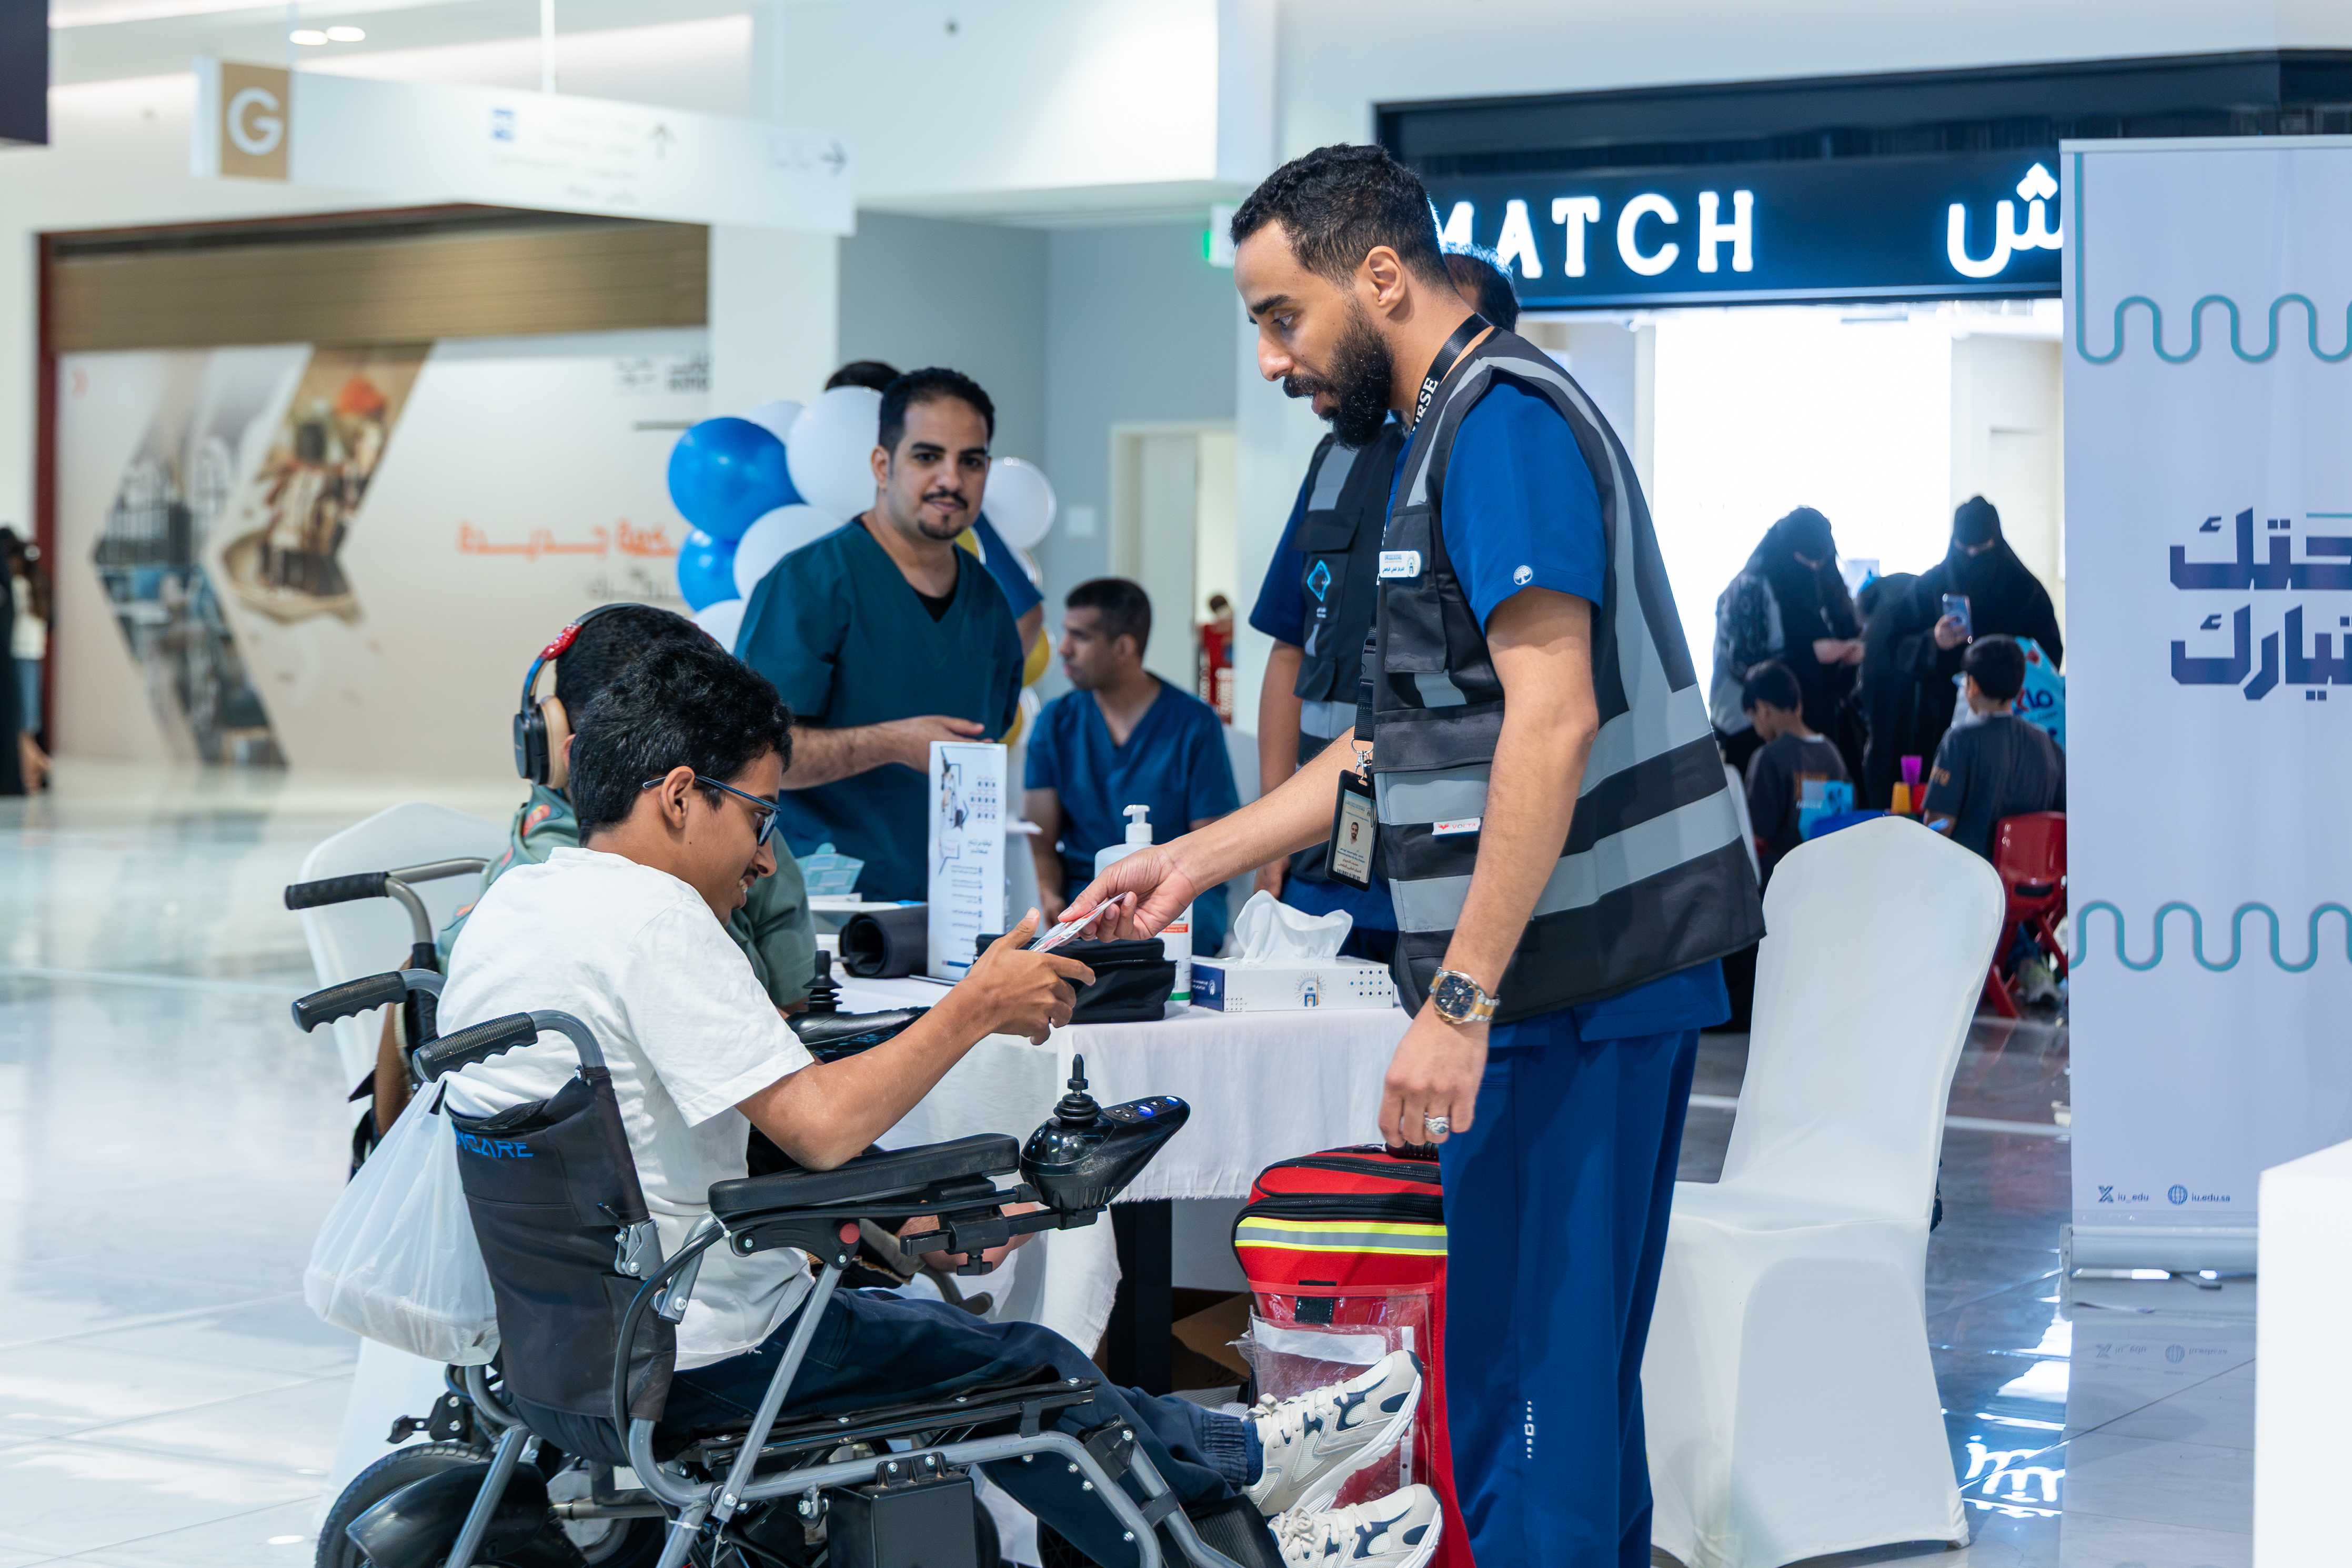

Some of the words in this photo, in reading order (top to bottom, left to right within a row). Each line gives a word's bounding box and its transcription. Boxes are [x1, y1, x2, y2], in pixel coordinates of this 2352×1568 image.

[227, 87, 284, 156] G
[1947, 162, 2063, 278] ش
[1411, 377, 1439, 434] RSE
[2169, 506, 2352, 591] حتك
